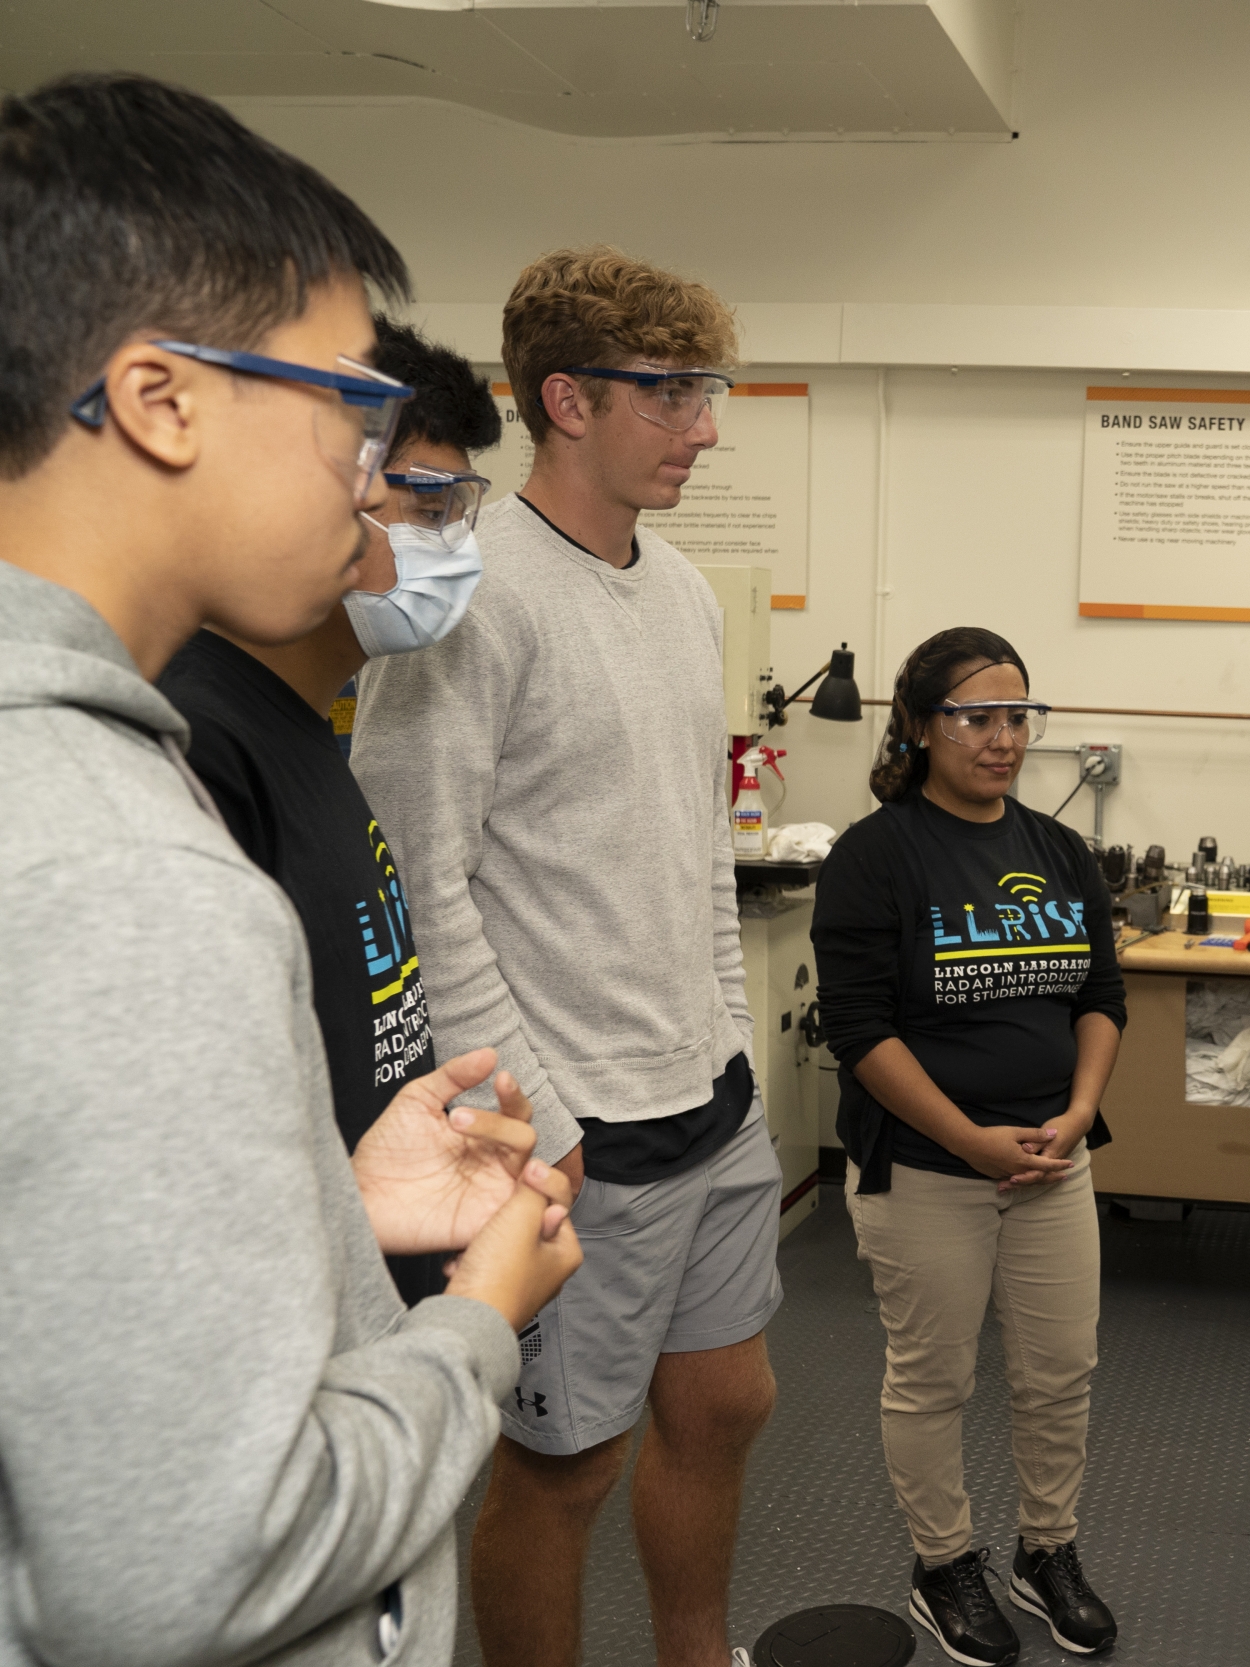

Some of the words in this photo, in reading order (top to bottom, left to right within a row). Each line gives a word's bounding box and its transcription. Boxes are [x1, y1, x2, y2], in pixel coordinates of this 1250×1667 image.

[1101, 414, 1143, 429] BAND
[1148, 415, 1182, 430] SAW
[1188, 416, 1246, 432] SAFETY
[934, 962, 1014, 978] LINCOLN
[934, 978, 994, 992] RADAR
[936, 994, 968, 1004] FOR
[973, 986, 1035, 1002] STUDENT
[374, 1060, 406, 1087] FOR
